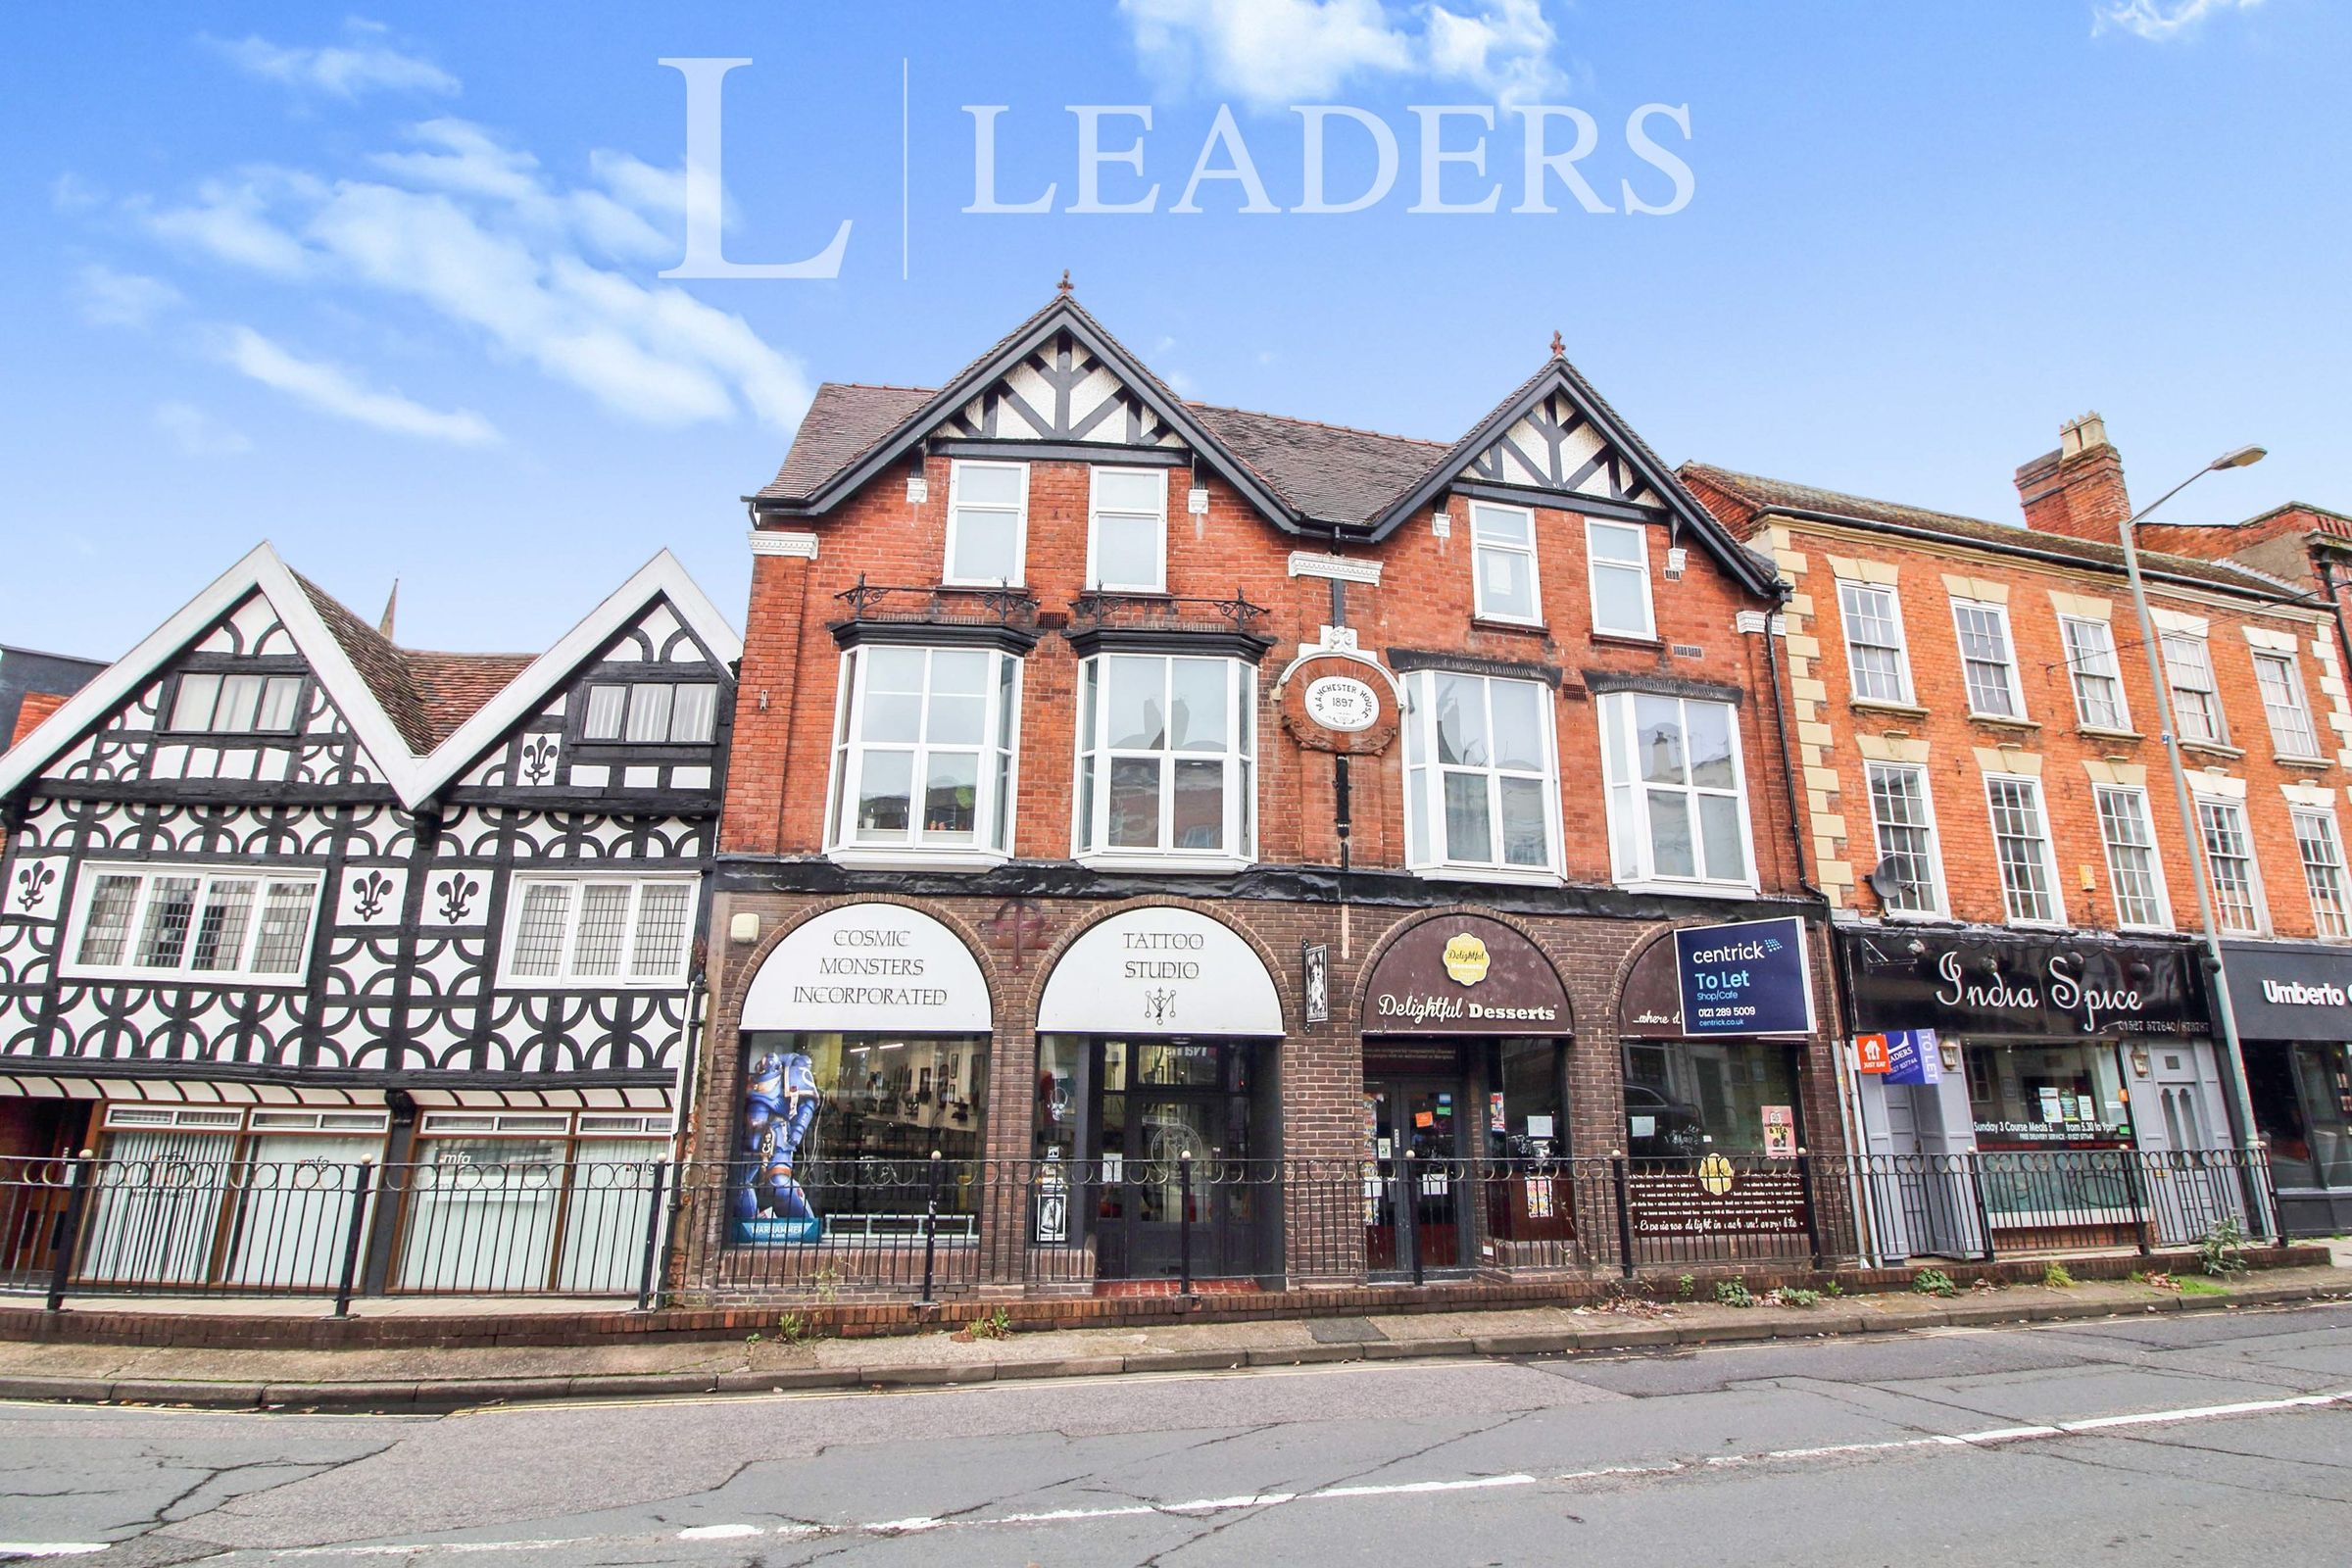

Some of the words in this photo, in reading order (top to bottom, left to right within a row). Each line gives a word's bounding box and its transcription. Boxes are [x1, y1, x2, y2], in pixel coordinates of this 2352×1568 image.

[1314, 683, 1357, 711] MANCHESTER
[1359, 689, 1373, 718] HOUSE
[1332, 697, 1353, 708] 1897
[833, 929, 911, 947] COSMIC
[1123, 933, 1204, 950] TATTOO
[1692, 940, 1765, 964] centrick
[819, 956, 924, 976] MONSTERS
[1124, 961, 1200, 980] STUDIO
[1694, 972, 1718, 990] To
[1722, 970, 1750, 988] Let
[793, 986, 948, 1005] INCORPORATED
[1696, 990, 1739, 1002] Shop/Cafe
[1936, 951, 2039, 1008] India
[2048, 956, 2143, 1032] Spice
[2262, 979, 2346, 1006] Umberto
[1378, 994, 1463, 1024] Delightful
[1468, 1003, 1556, 1020] Desserts
[1698, 1007, 1714, 1017] 0121
[1716, 1006, 1732, 1017] 289
[1733, 1005, 1755, 1016] 5009
[1698, 1018, 1744, 1027] centrick.co.uk
[2118, 1020, 2143, 1032] 01527
[1921, 1032, 1934, 1052] TO
[1889, 1047, 1914, 1063] ADERS
[1925, 1054, 1938, 1080] LET
[1974, 1121, 1998, 1134] Sunday
[1999, 1121, 2004, 1132] 3
[2005, 1121, 2028, 1132] Course
[2029, 1122, 2048, 1132] Meals
[2066, 1122, 2081, 1132] from
[751, 1225, 803, 1235] WARHAMMER
[1784, 1216, 1797, 1228] bte
